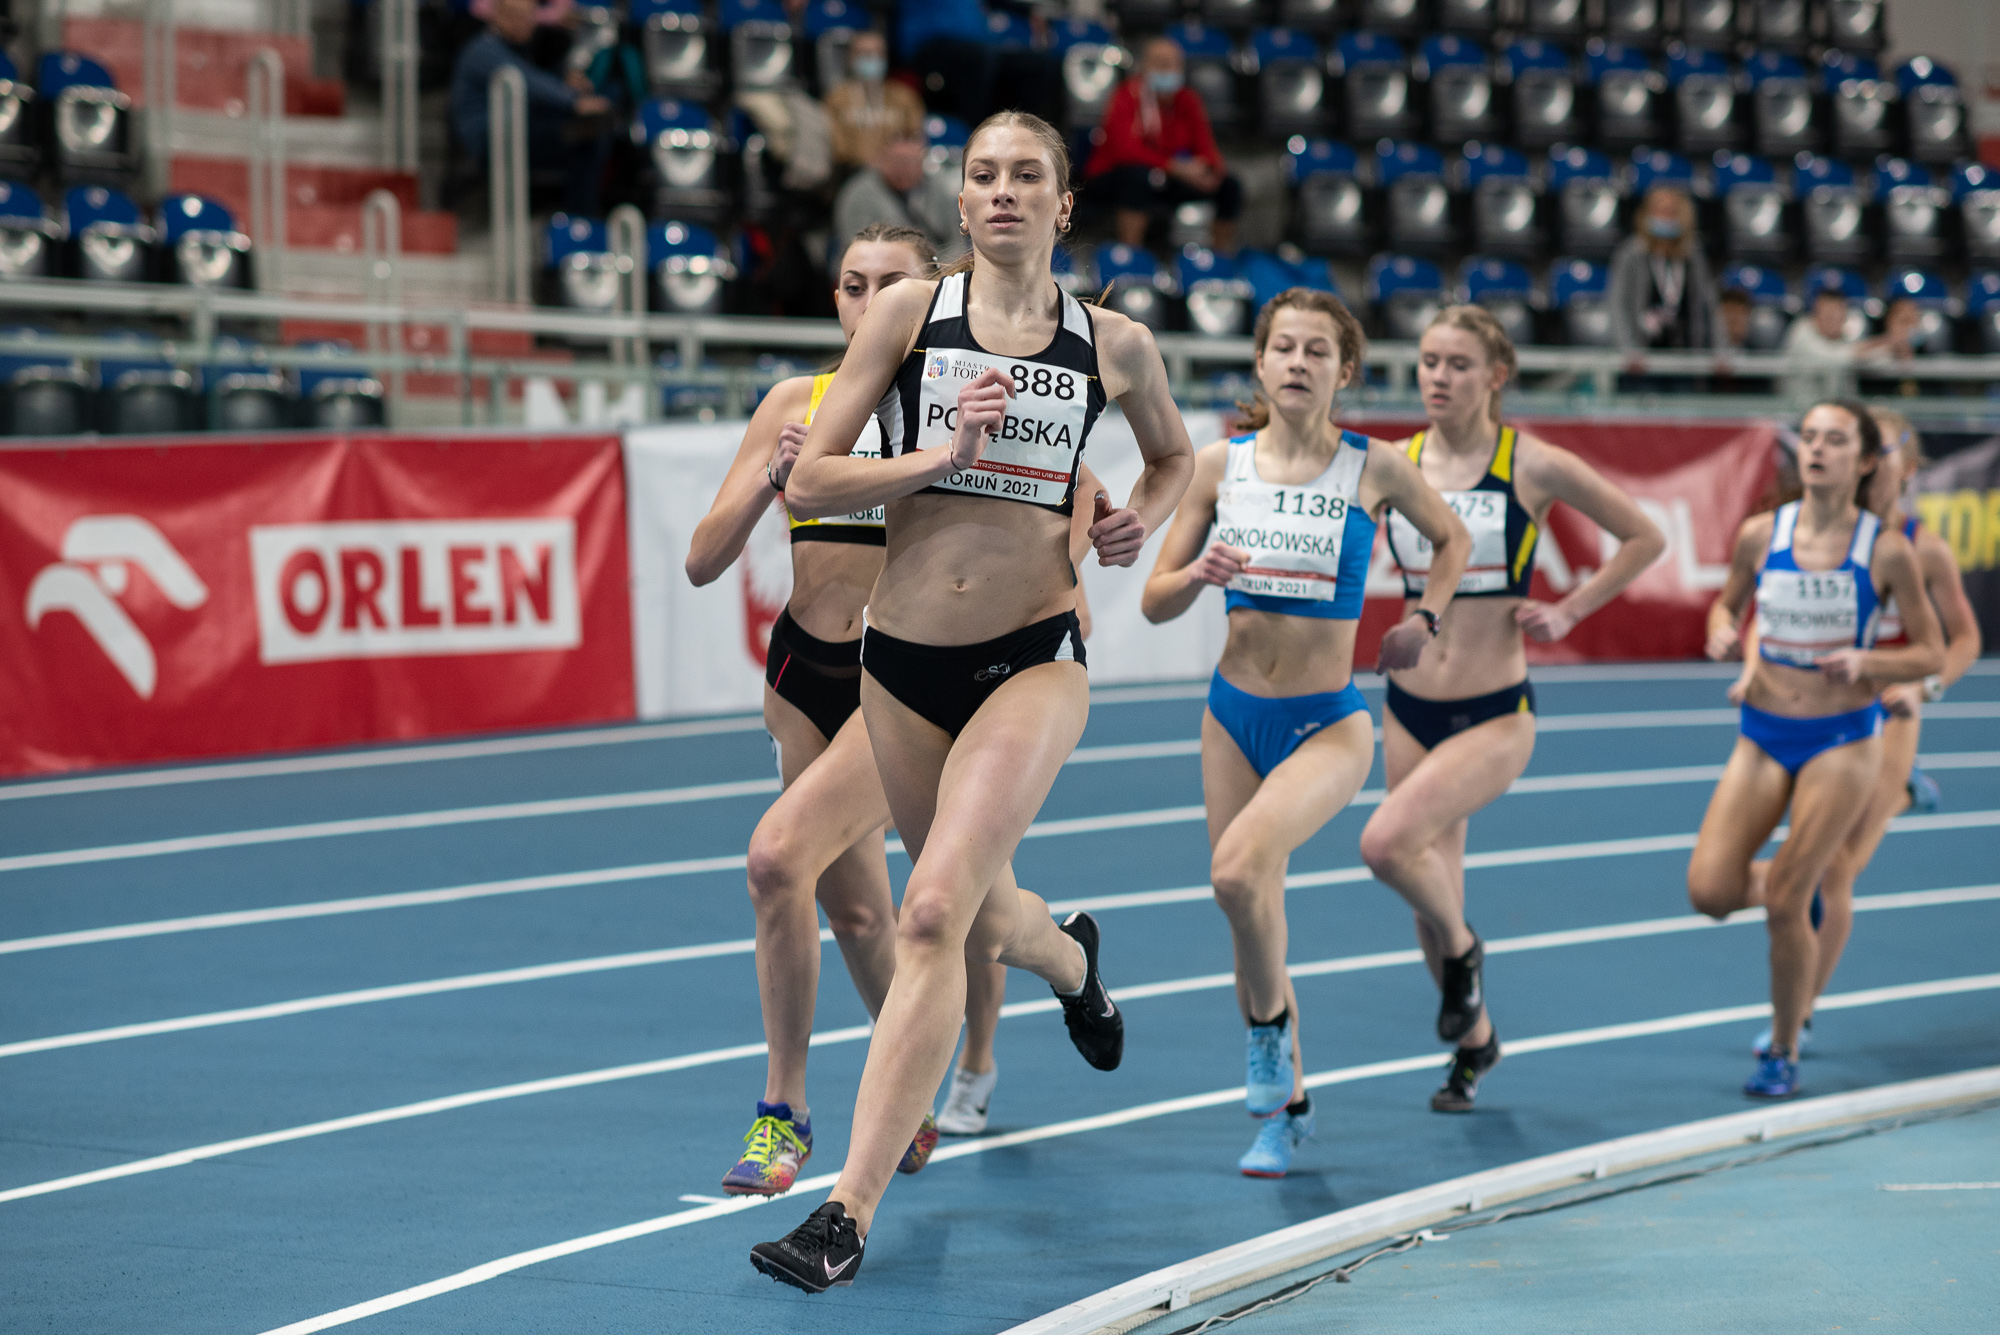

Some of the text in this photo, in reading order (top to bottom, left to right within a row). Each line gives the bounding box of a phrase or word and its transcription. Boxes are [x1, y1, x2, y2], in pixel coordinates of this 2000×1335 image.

[1001, 479, 1039, 498] 2021
[1273, 490, 1346, 520] 1138
[1218, 527, 1336, 558] SOKOŁOWSKA
[278, 542, 555, 640] ORLEN
[1277, 581, 1307, 595] 2021
